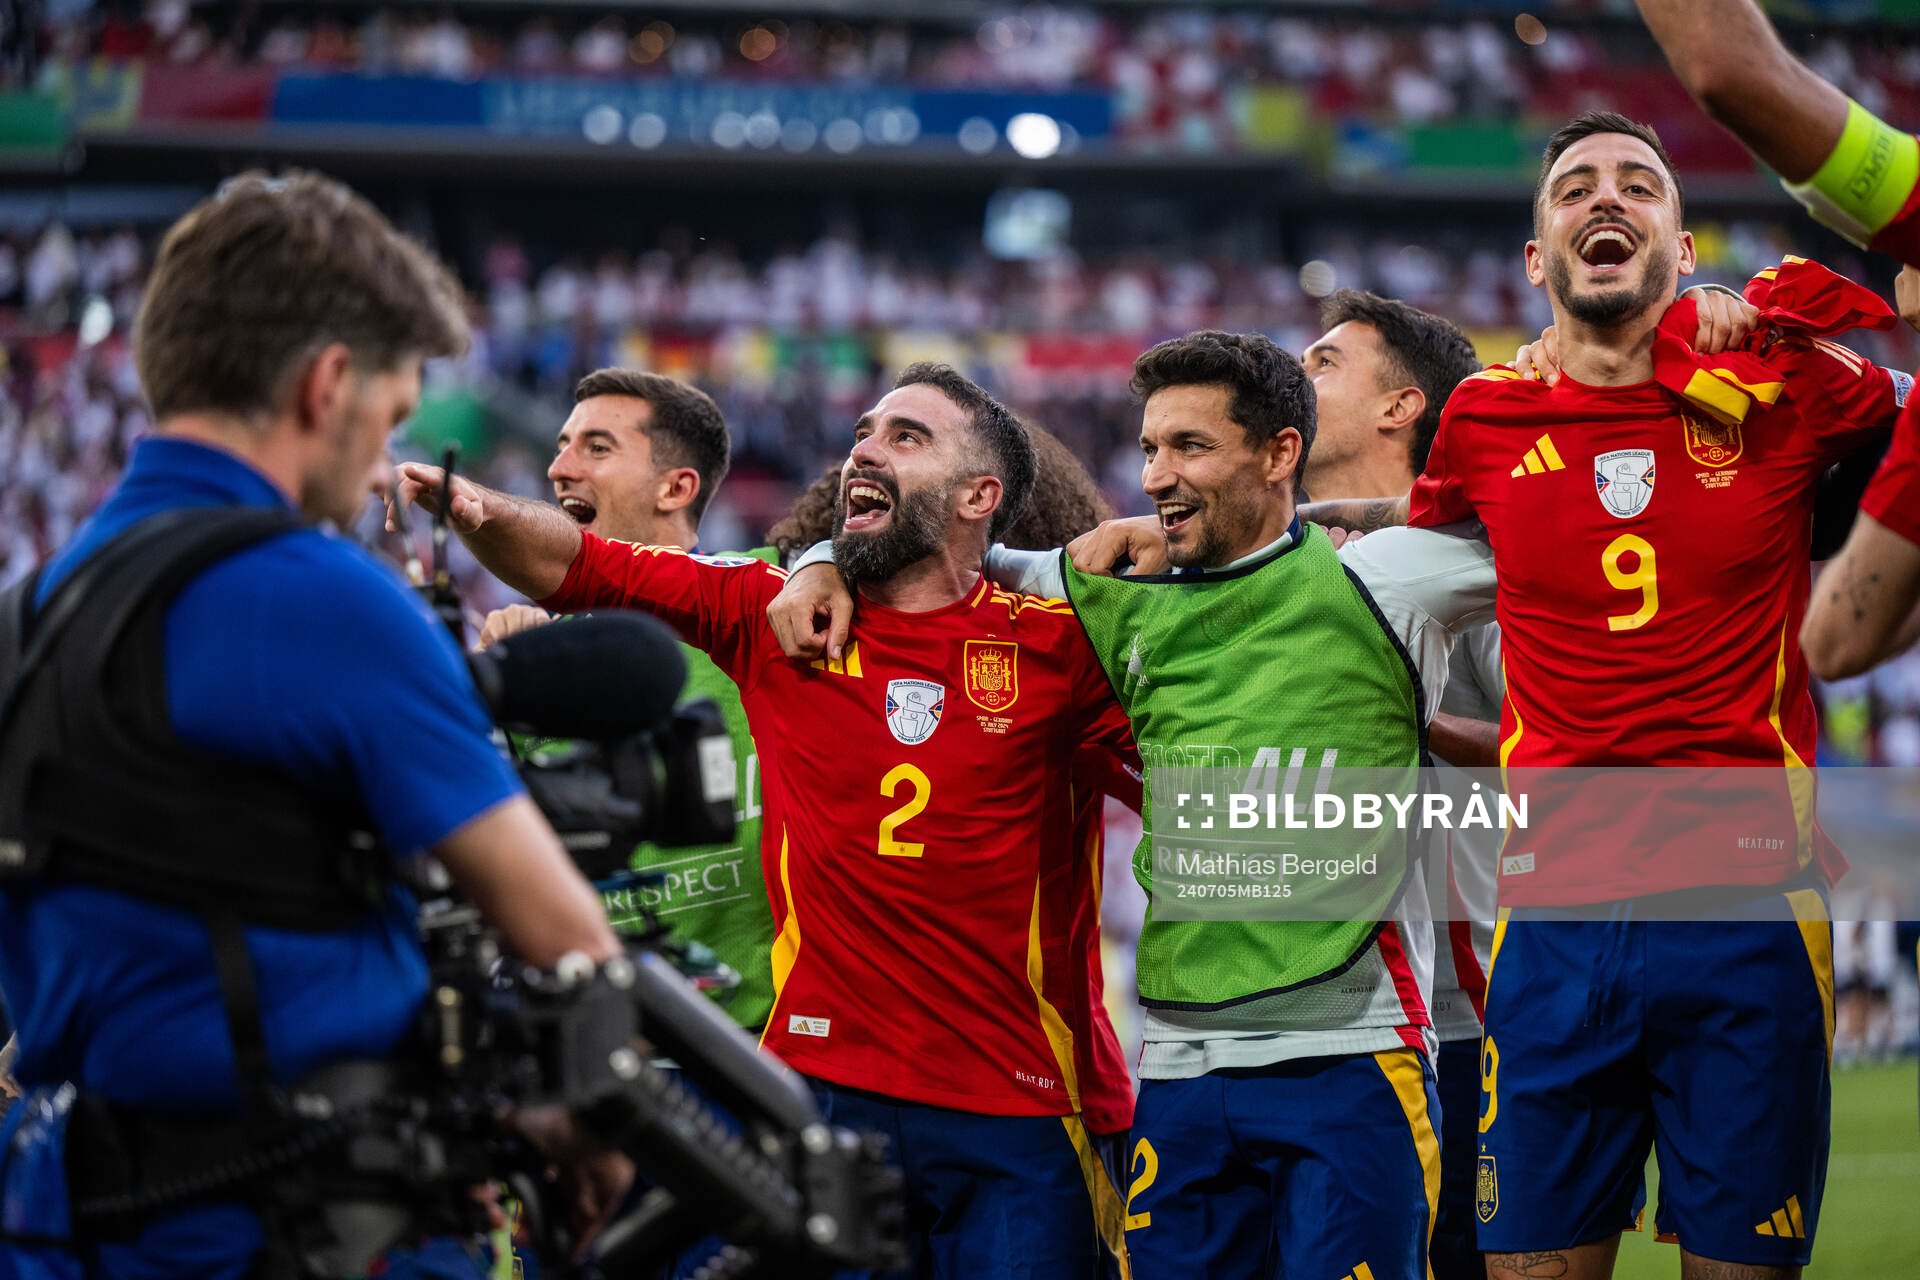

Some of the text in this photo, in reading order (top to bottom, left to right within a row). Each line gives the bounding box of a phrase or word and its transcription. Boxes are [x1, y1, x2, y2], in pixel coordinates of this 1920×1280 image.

[1601, 533, 1659, 632] 9
[878, 762, 931, 858] 2
[1738, 837, 1785, 850] HEAT.RDY
[1125, 1137, 1159, 1231] 2
